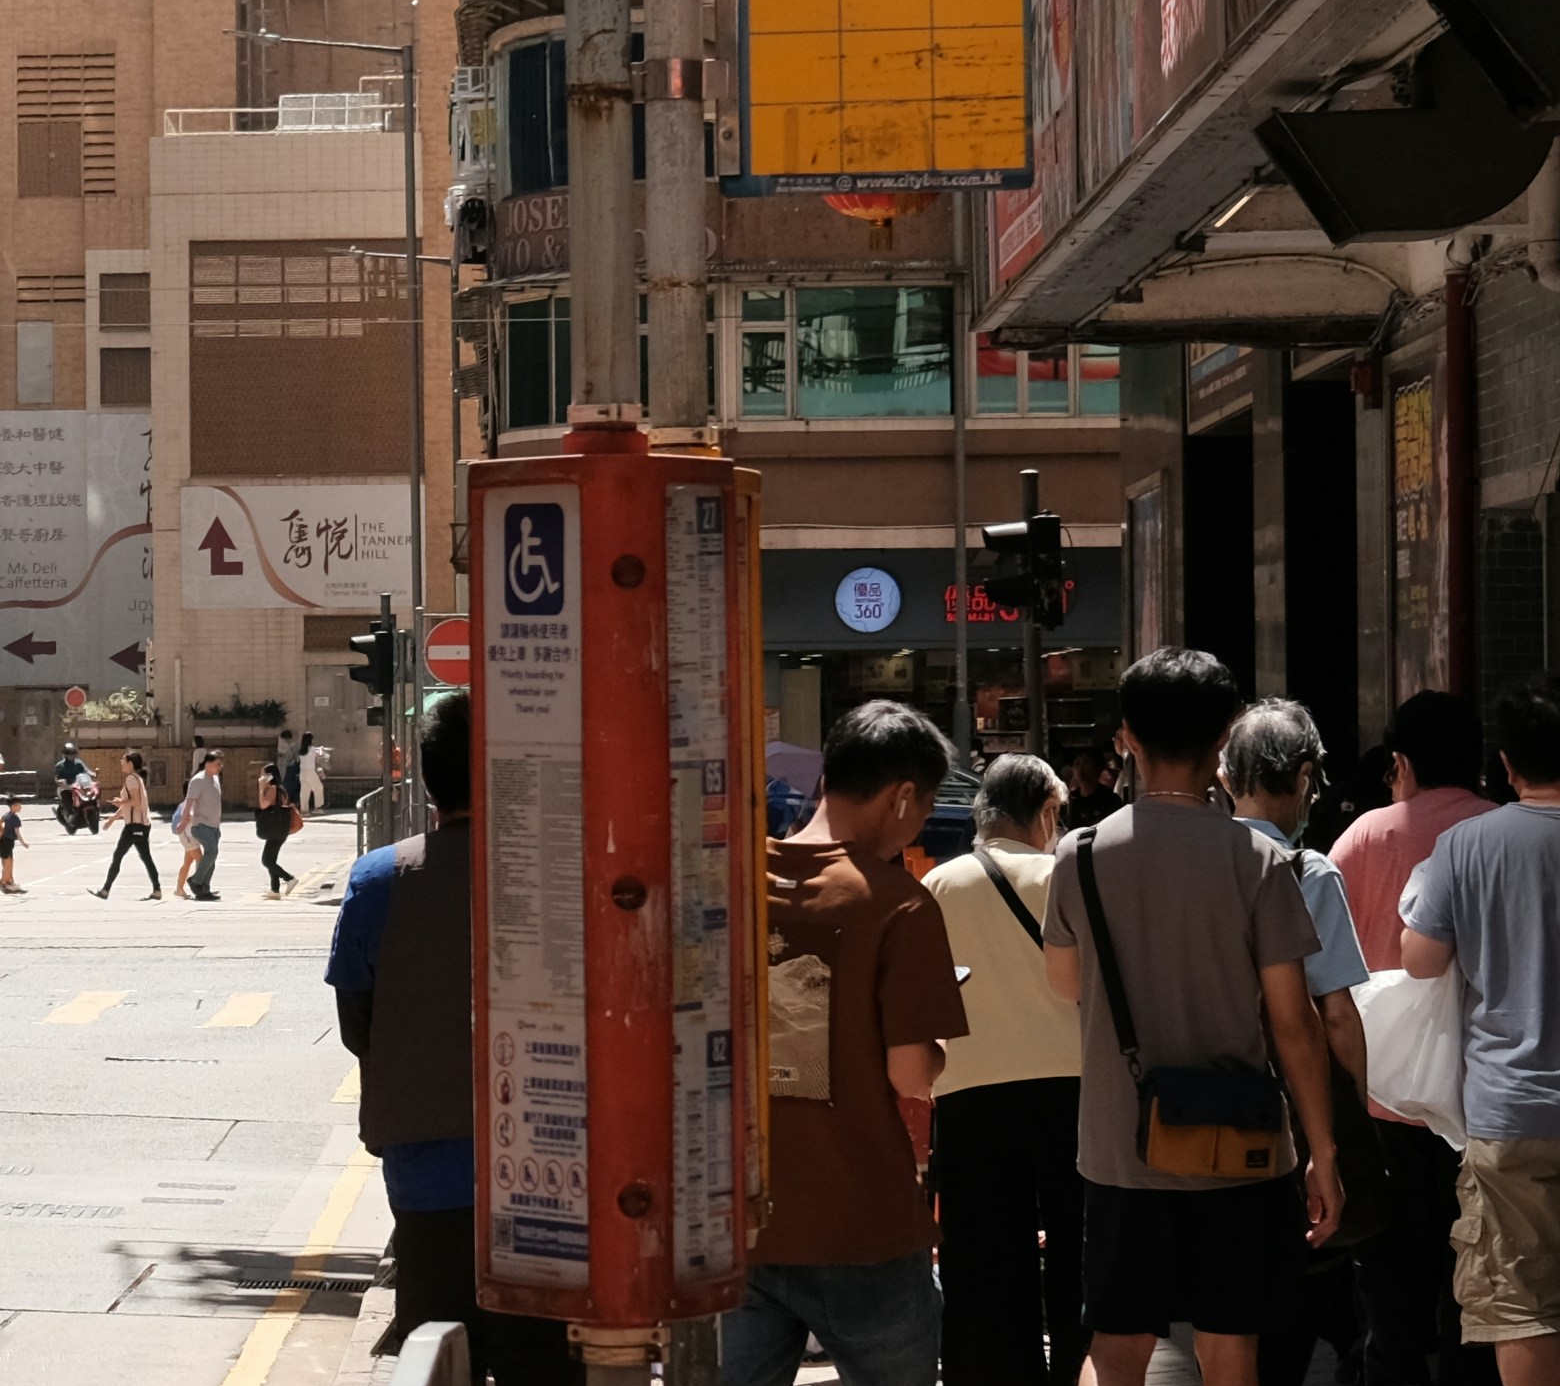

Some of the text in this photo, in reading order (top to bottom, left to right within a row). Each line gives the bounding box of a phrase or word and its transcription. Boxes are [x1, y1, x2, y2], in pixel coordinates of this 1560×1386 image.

[505, 194, 570, 238] JOSE
[700, 501, 718, 530] 27
[361, 522, 385, 533] THE
[361, 535, 413, 546] TANNER
[361, 549, 390, 560] HILL
[7, 562, 58, 575] Ms Deli
[704, 763, 723, 792] 65
[711, 1037, 729, 1064] 82
